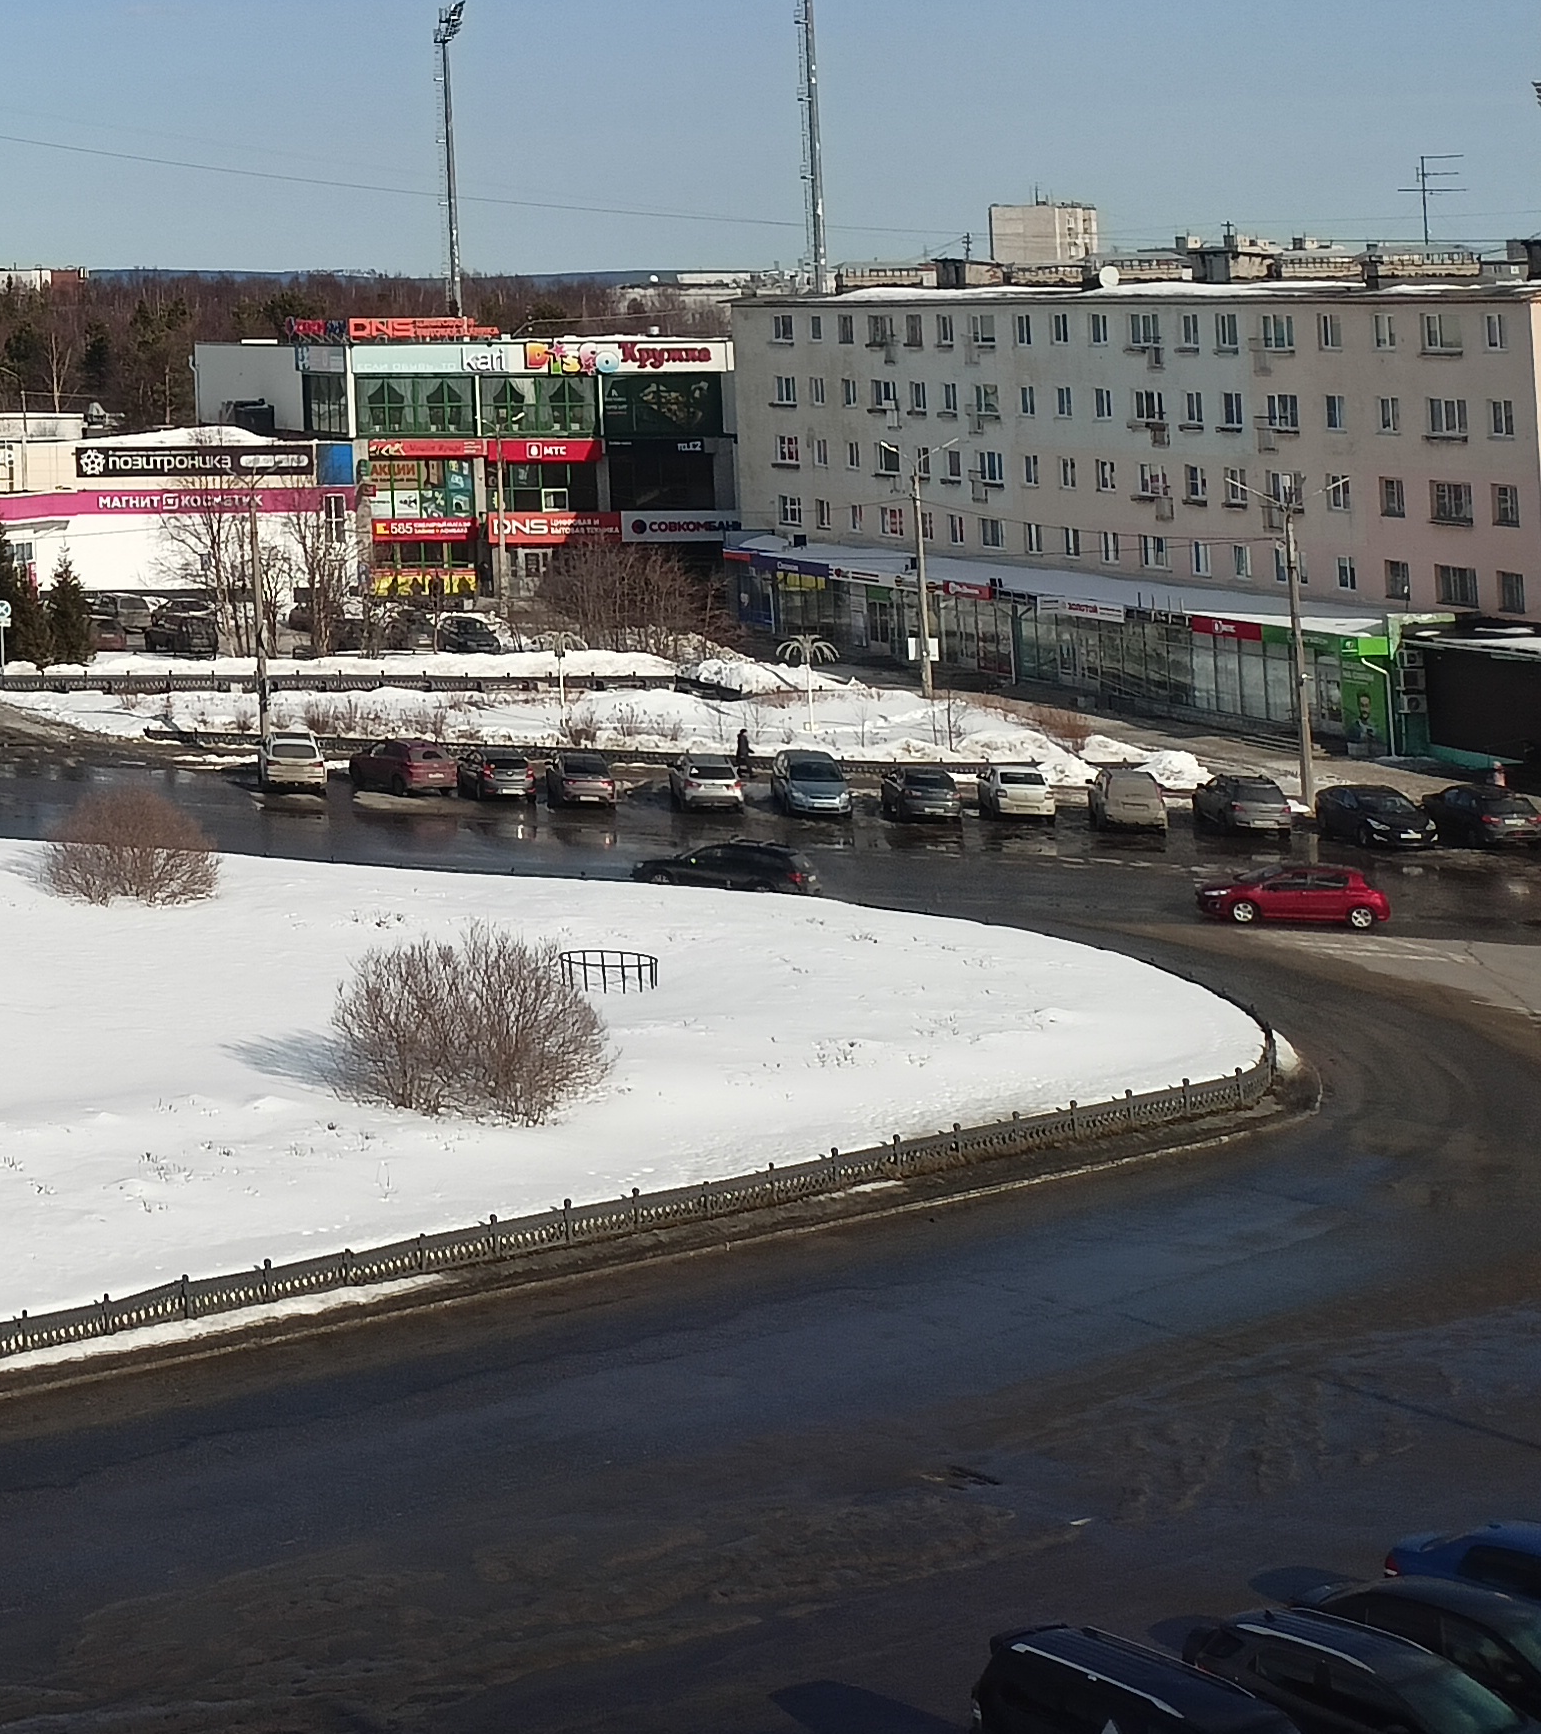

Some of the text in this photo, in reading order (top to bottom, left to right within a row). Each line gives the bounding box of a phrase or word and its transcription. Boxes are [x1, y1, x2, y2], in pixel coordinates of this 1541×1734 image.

[349, 318, 414, 337] DNS
[460, 347, 506, 372] kari
[618, 342, 712, 368] Кружка
[543, 445, 567, 456] МТС
[98, 494, 160, 509] МАГНИТ
[390, 522, 413, 535] 585
[493, 518, 549, 535] DNS
[649, 519, 741, 532] СОВКОМБАНК
